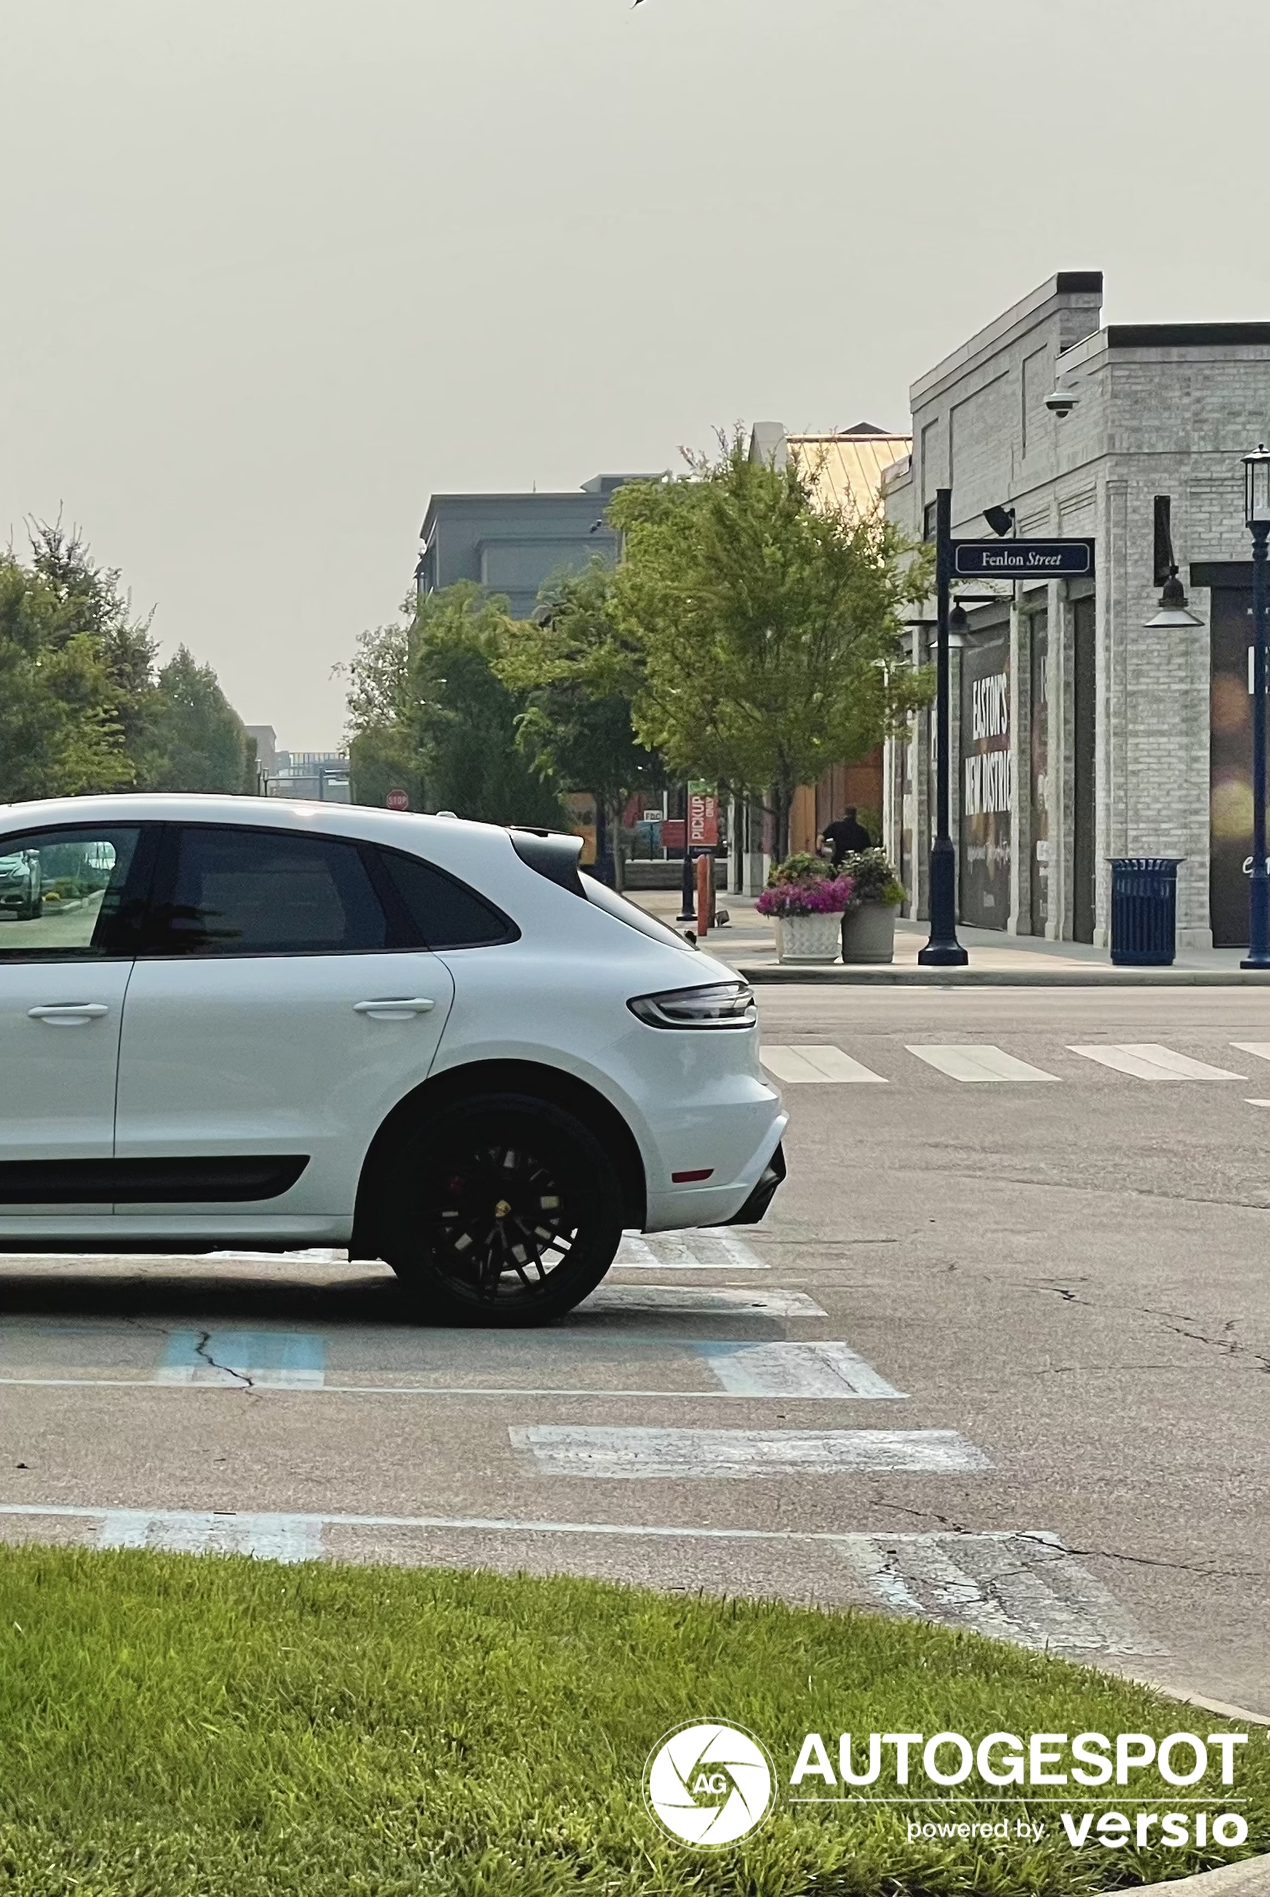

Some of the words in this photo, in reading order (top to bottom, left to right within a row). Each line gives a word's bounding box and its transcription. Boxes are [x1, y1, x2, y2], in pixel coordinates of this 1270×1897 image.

[981, 551, 1024, 566] Fenlon
[1026, 552, 1062, 566] Street
[972, 672, 1008, 741] EASTON'S
[965, 754, 981, 816] NEW
[982, 749, 1011, 813] DISTRIC
[388, 796, 407, 805] STOP
[705, 796, 715, 818] ONLY
[691, 796, 705, 840] PICKUP
